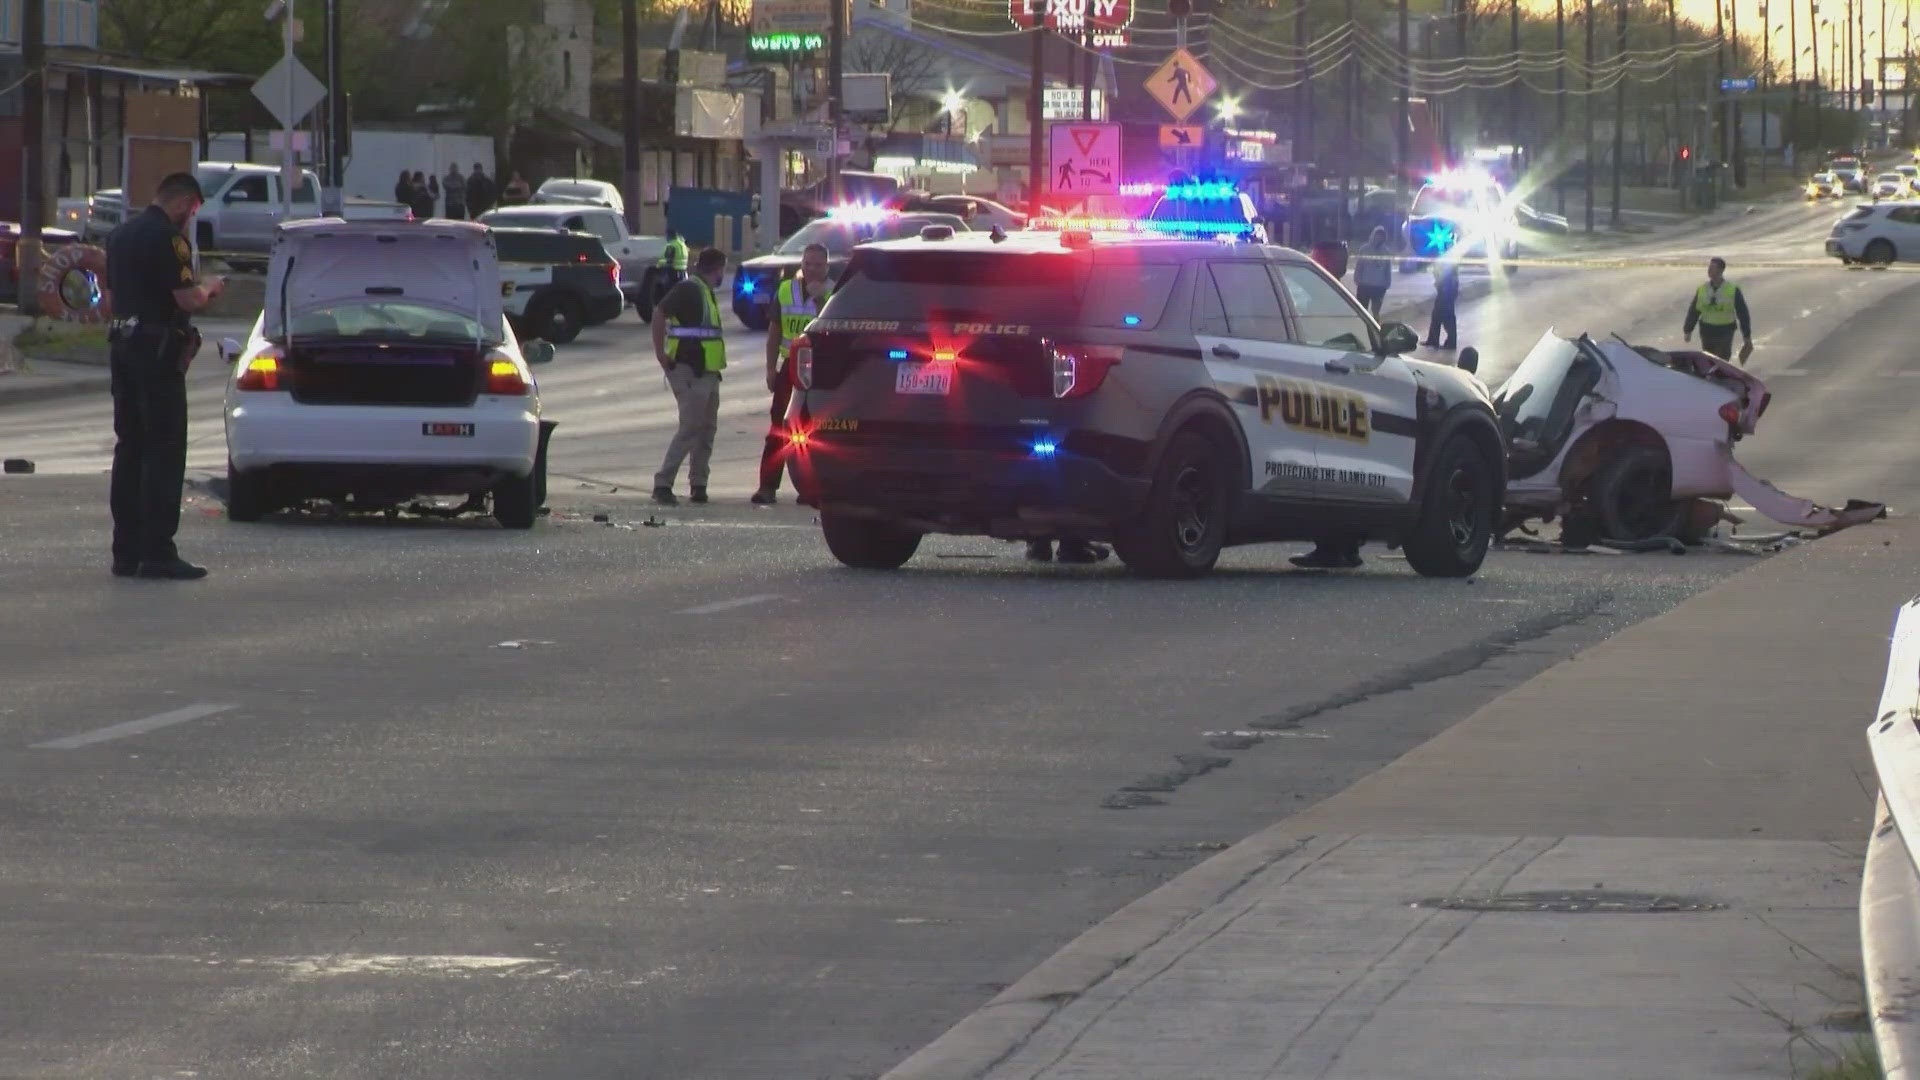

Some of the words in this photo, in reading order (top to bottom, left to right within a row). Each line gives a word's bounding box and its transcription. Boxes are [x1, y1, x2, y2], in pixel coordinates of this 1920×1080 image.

[1056, 14, 1085, 28] INN
[1089, 157, 1110, 167] HERE
[1080, 177, 1091, 187] TO
[40, 247, 83, 293] SHOP
[953, 322, 1031, 336] POLICE
[1257, 380, 1368, 443] POLICE
[1265, 461, 1319, 481] PROTECTING
[1321, 467, 1336, 482] THE
[1339, 469, 1366, 484] ALAMO
[1368, 472, 1387, 487] CITY
